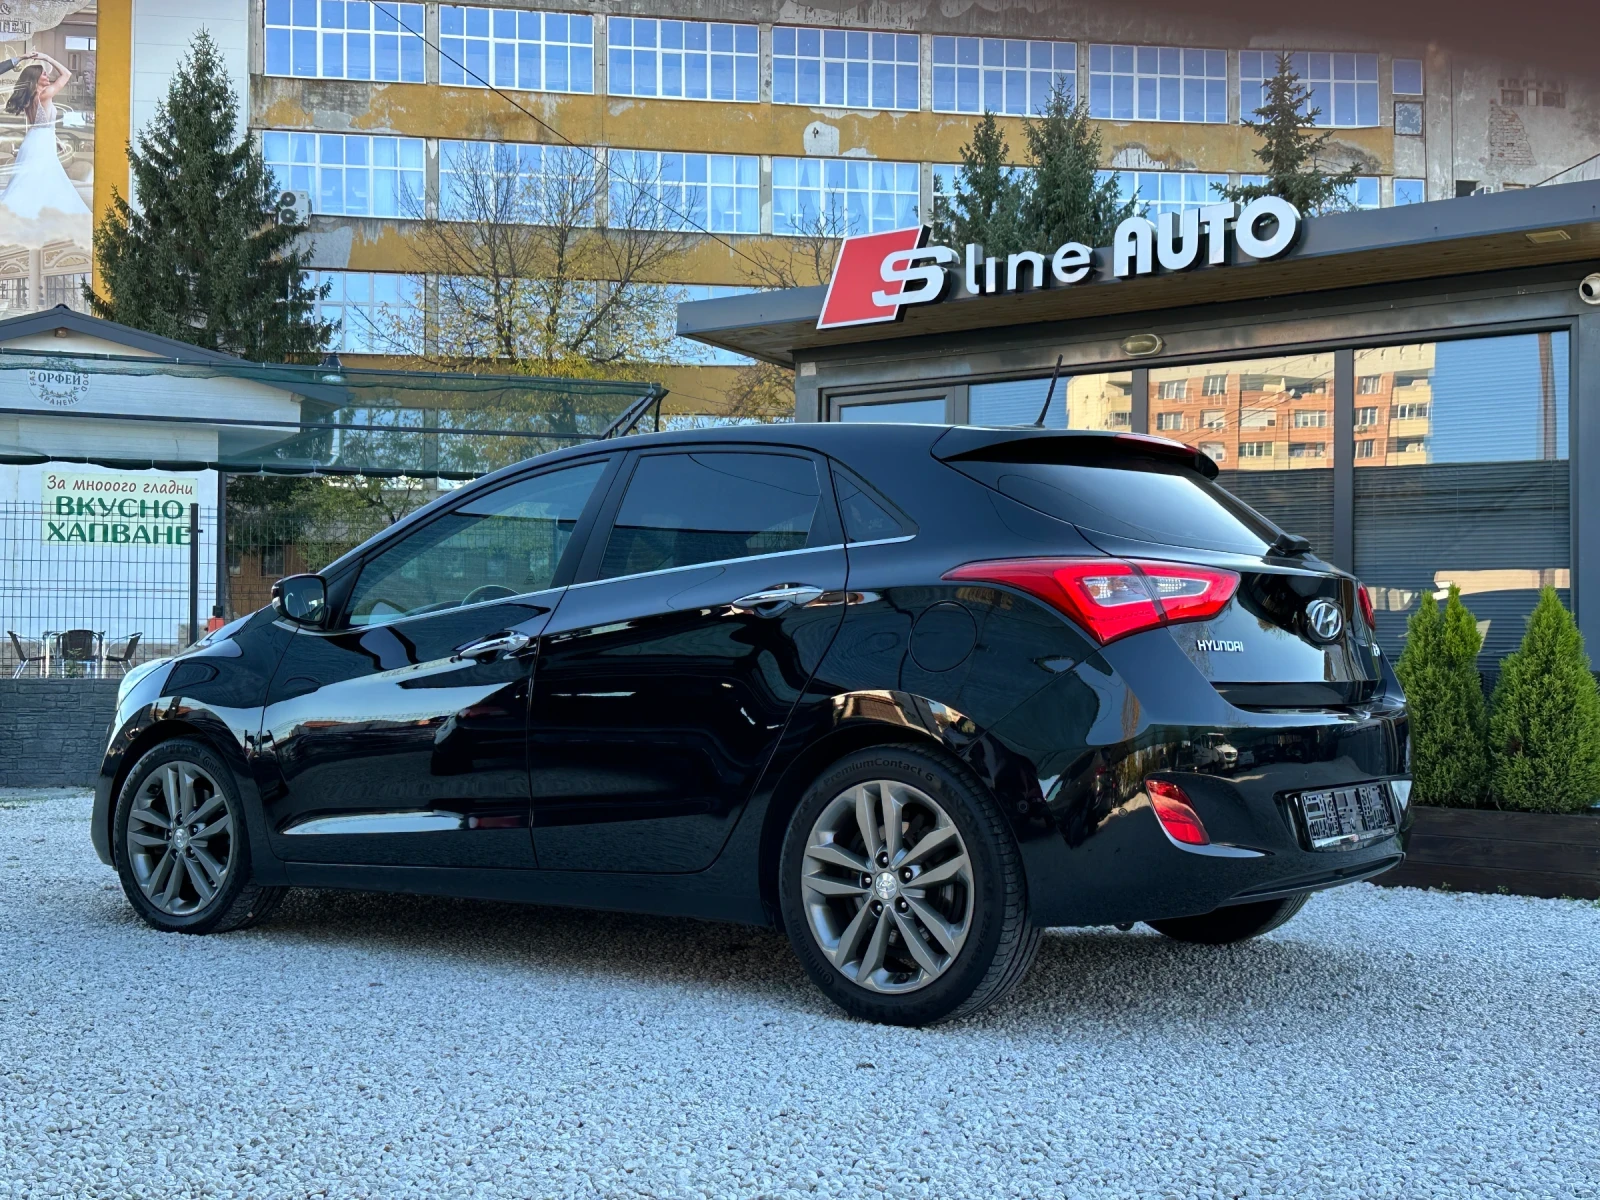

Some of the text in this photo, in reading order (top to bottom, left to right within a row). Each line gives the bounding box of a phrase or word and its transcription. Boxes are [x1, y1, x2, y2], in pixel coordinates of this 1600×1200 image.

[1113, 196, 1297, 277] AUTO
[38, 371, 81, 386] ОРФЕЙ
[47, 475, 193, 495] За мнооого гладни
[56, 496, 184, 519] ВКУСНО
[47, 522, 191, 545] ХАПВАНЕ
[1197, 639, 1244, 652] HYUNDAI
[823, 758, 935, 786] PremiumContact 6
